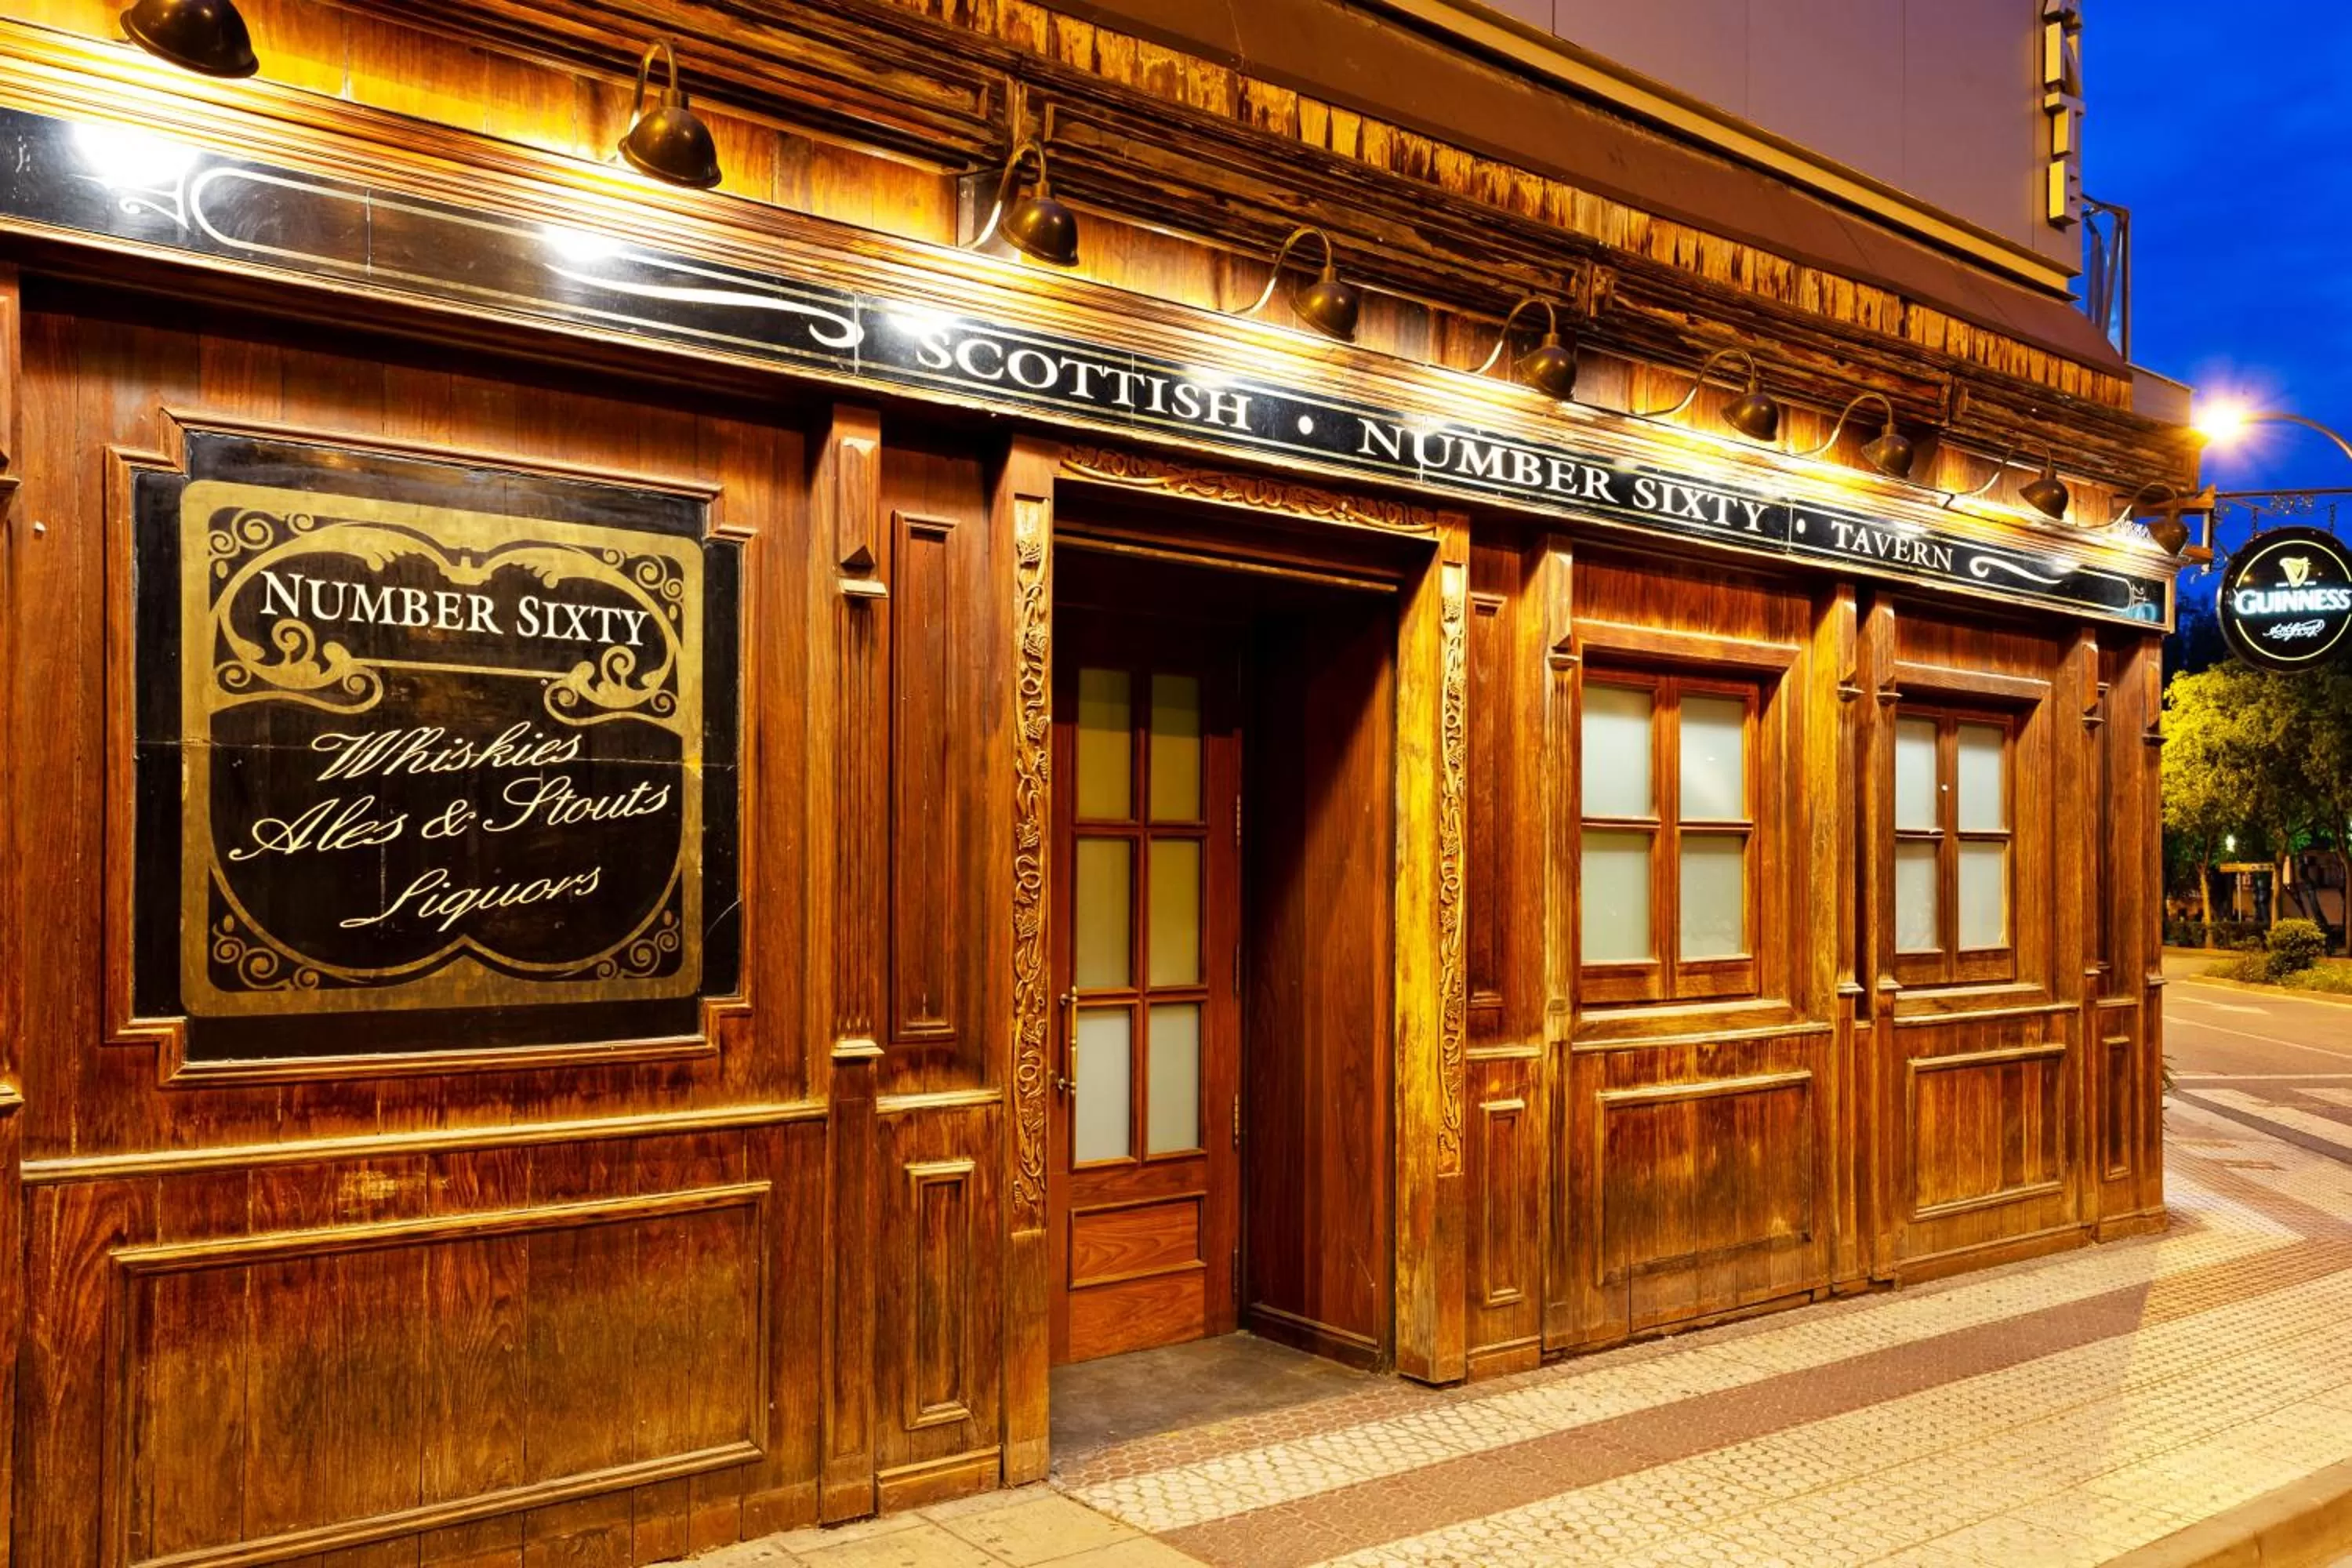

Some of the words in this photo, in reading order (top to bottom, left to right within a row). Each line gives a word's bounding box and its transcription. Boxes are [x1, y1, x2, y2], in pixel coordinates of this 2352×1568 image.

[915, 331, 1254, 431] SCOTTISH
[1357, 417, 1620, 503] NUMBER
[1632, 478, 1769, 533] SIXTY
[1831, 520, 1955, 573] TAVERN
[260, 571, 503, 635] NUMBER
[515, 595, 651, 647] SIXTY
[2234, 588, 2351, 615] GUINNESS
[311, 720, 583, 782] Whiskies
[228, 794, 409, 861] Ales
[420, 799, 477, 840] &
[482, 776, 671, 832] Stouts
[339, 866, 601, 933] Liquors
